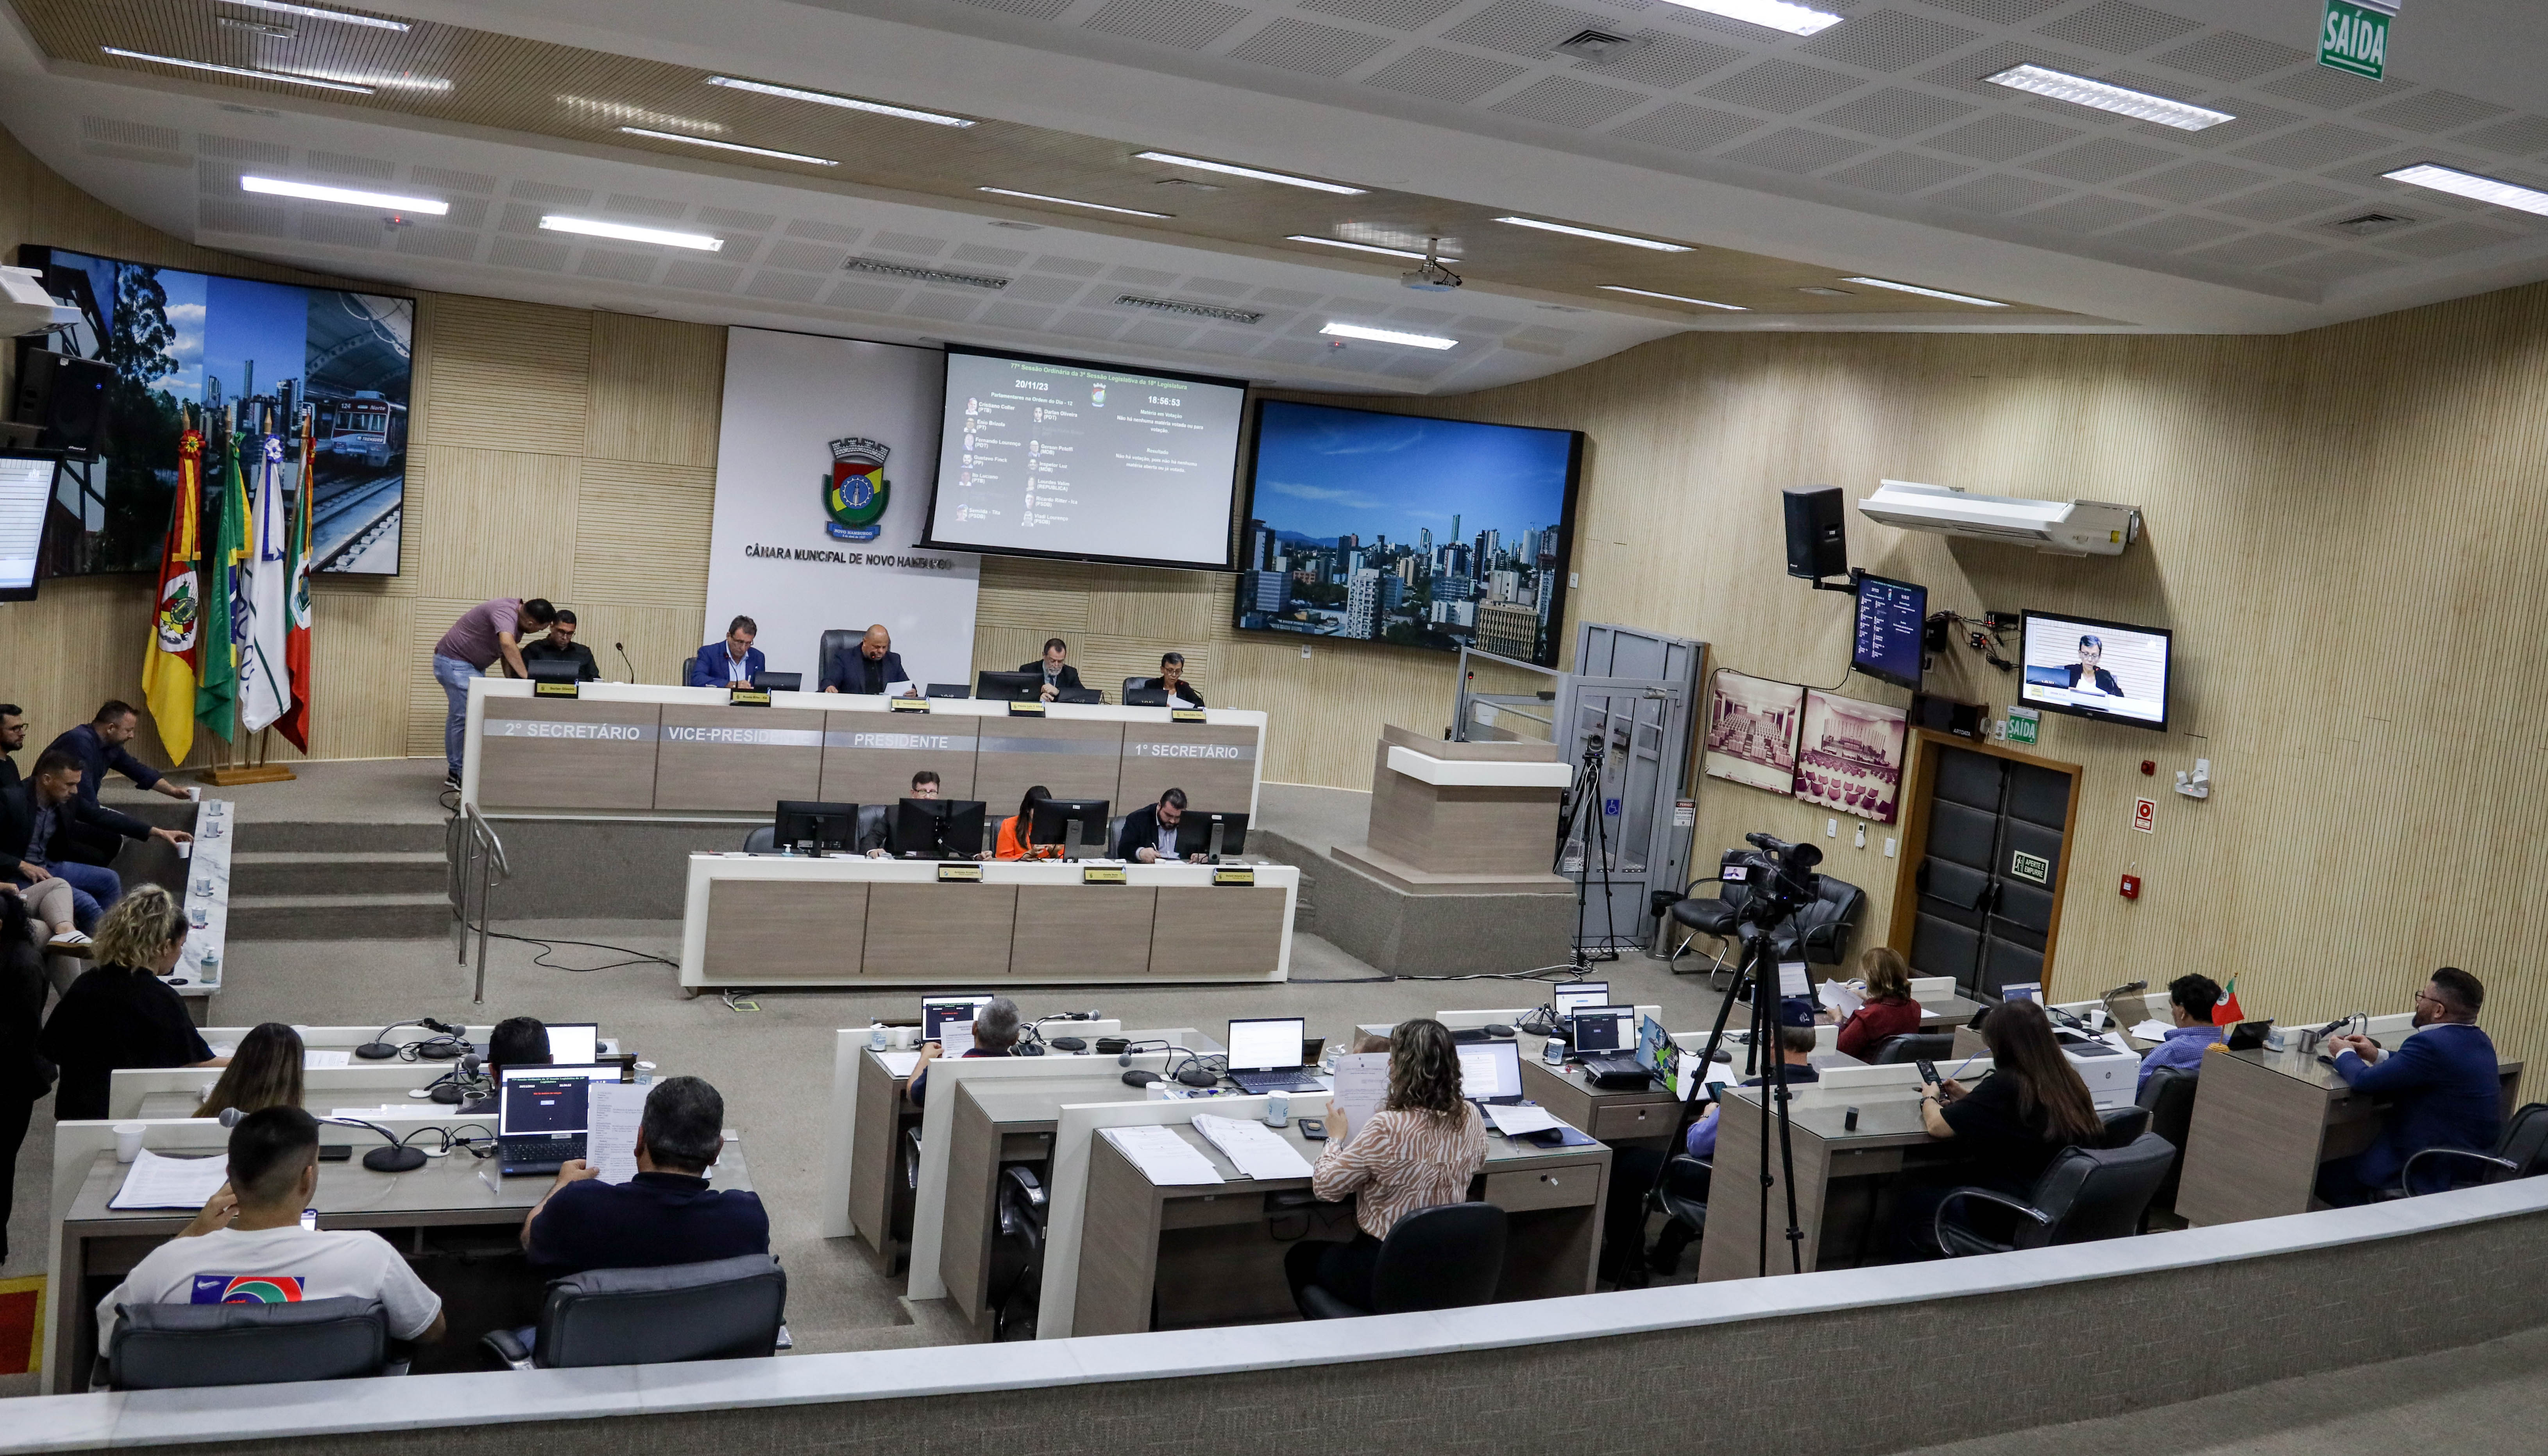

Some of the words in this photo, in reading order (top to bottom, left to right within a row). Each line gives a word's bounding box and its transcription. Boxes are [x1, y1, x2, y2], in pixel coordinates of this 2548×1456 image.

[2323, 10, 2384, 65] SAÍDA
[1021, 364, 1042, 372] Sessão
[1043, 367, 1070, 376] Ordinária
[1108, 376, 1138, 385] Legislativa
[1157, 381, 1188, 390] Legislatura
[1015, 380, 1049, 391] 20/11/23
[991, 392, 1025, 401] Parlamentares
[1148, 395, 1181, 407] 18:56:53
[745, 542, 791, 560] CÂMARA
[794, 548, 846, 563] MUNICIPAL
[849, 553, 863, 565] DE
[866, 554, 895, 567] NOVO
[897, 556, 952, 570] HAMBURGO
[527, 723, 640, 740] SECRETÁRIO
[1953, 728, 1971, 737] ARTDATA
[2008, 718, 2035, 739] SAÍDA
[854, 733, 948, 748] PRESIDENTE
[1151, 744, 1238, 758] SECRETÁRIO
[2025, 859, 2042, 870] APERTE
[2024, 866, 2043, 878] EMPURRE
